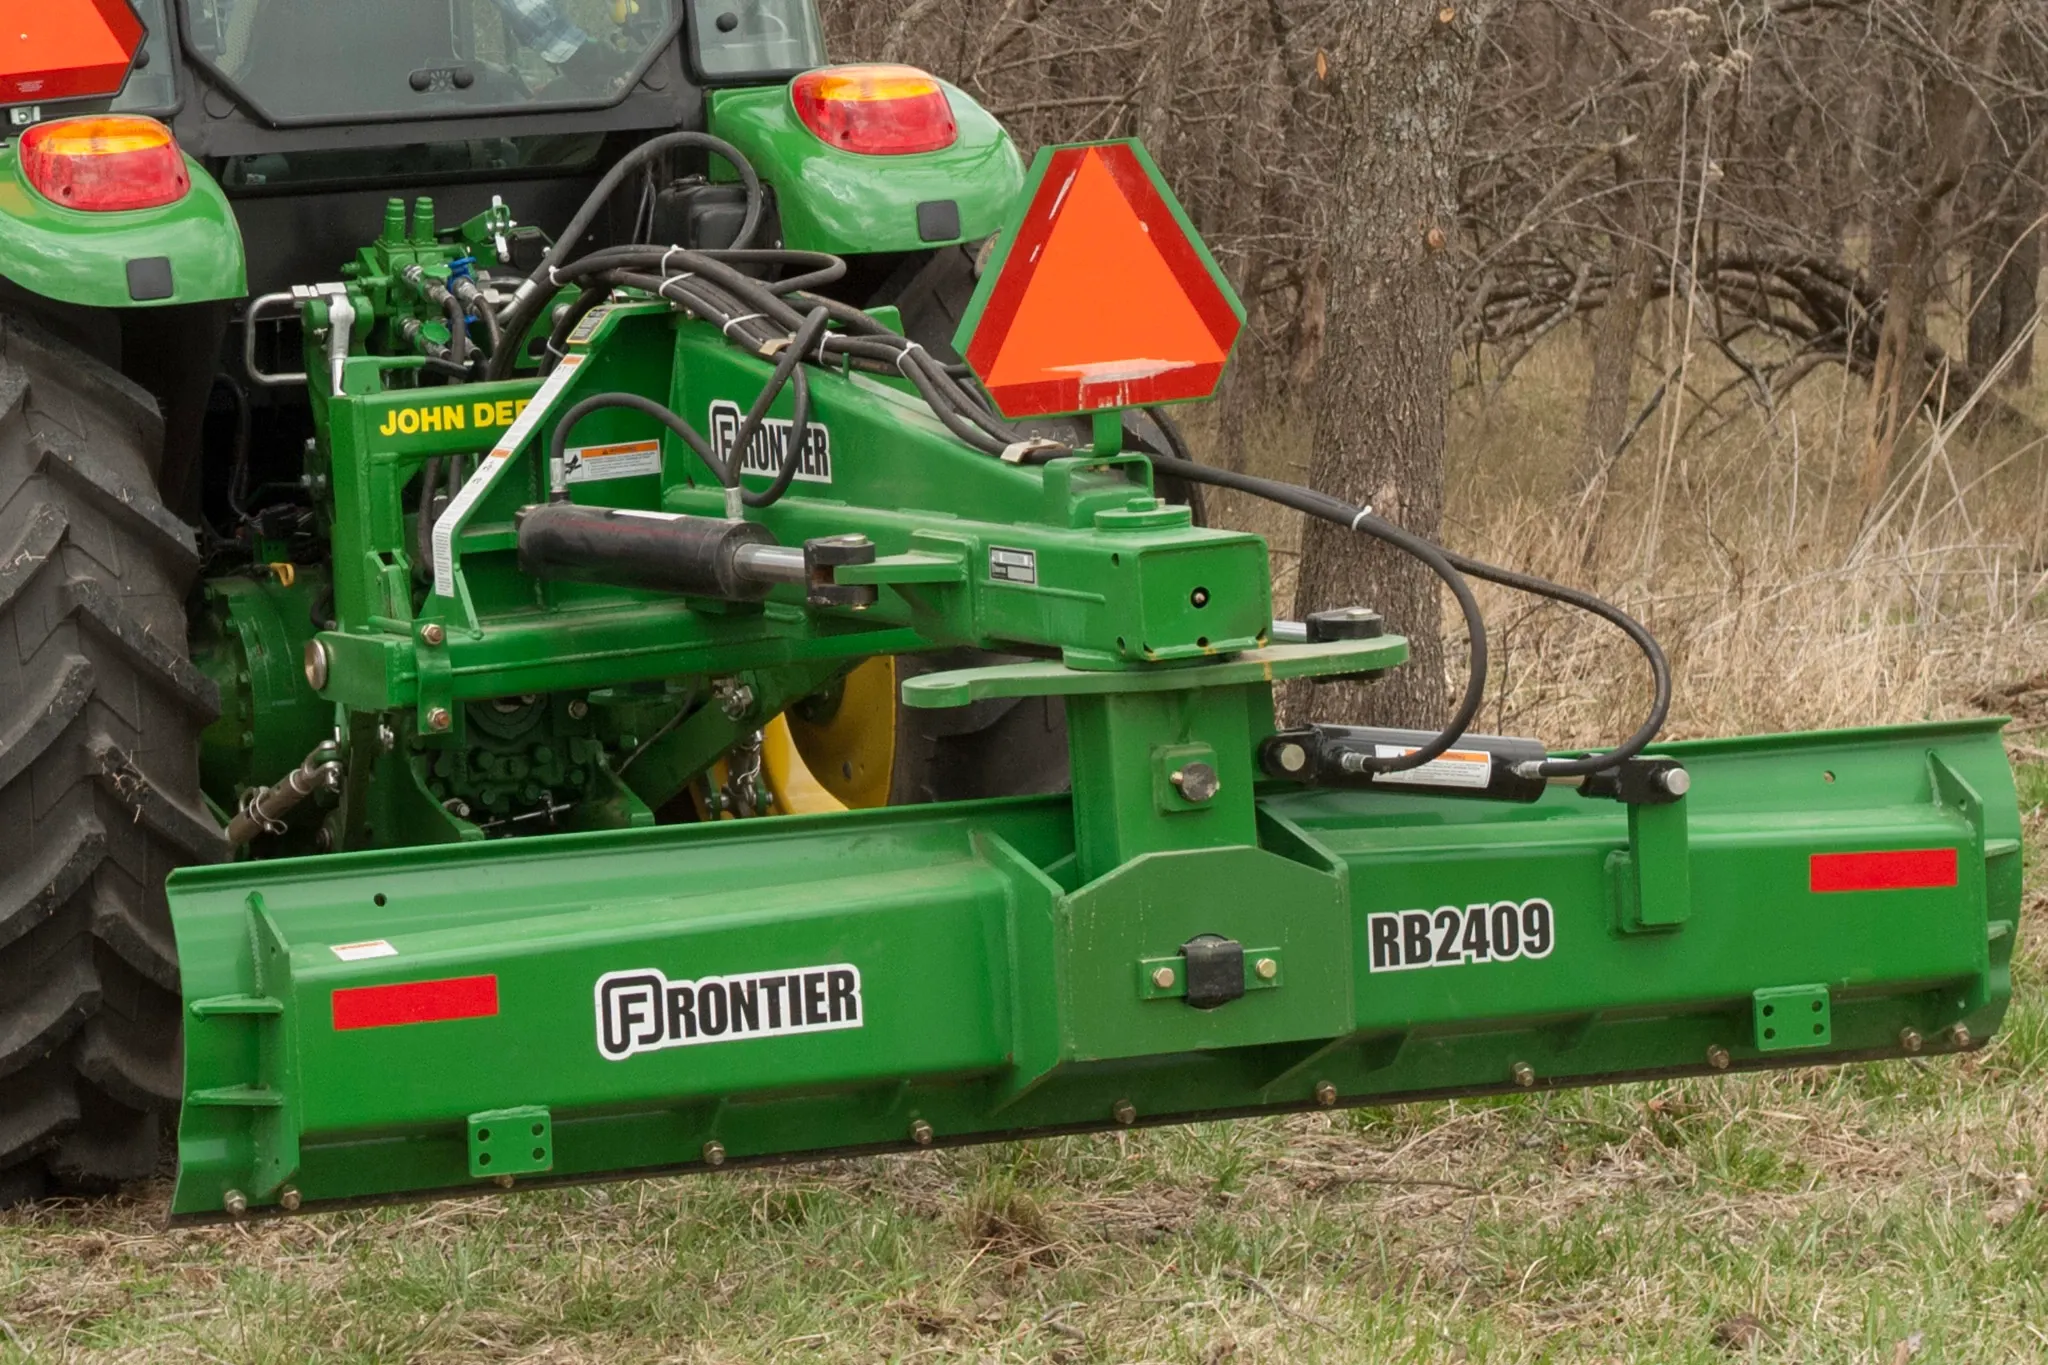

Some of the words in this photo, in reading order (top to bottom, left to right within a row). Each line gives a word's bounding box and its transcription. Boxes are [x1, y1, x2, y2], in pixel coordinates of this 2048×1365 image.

[379, 404, 465, 437] JOHN
[1371, 902, 1552, 969] RB2409
[601, 970, 858, 1054] FRONTIER
